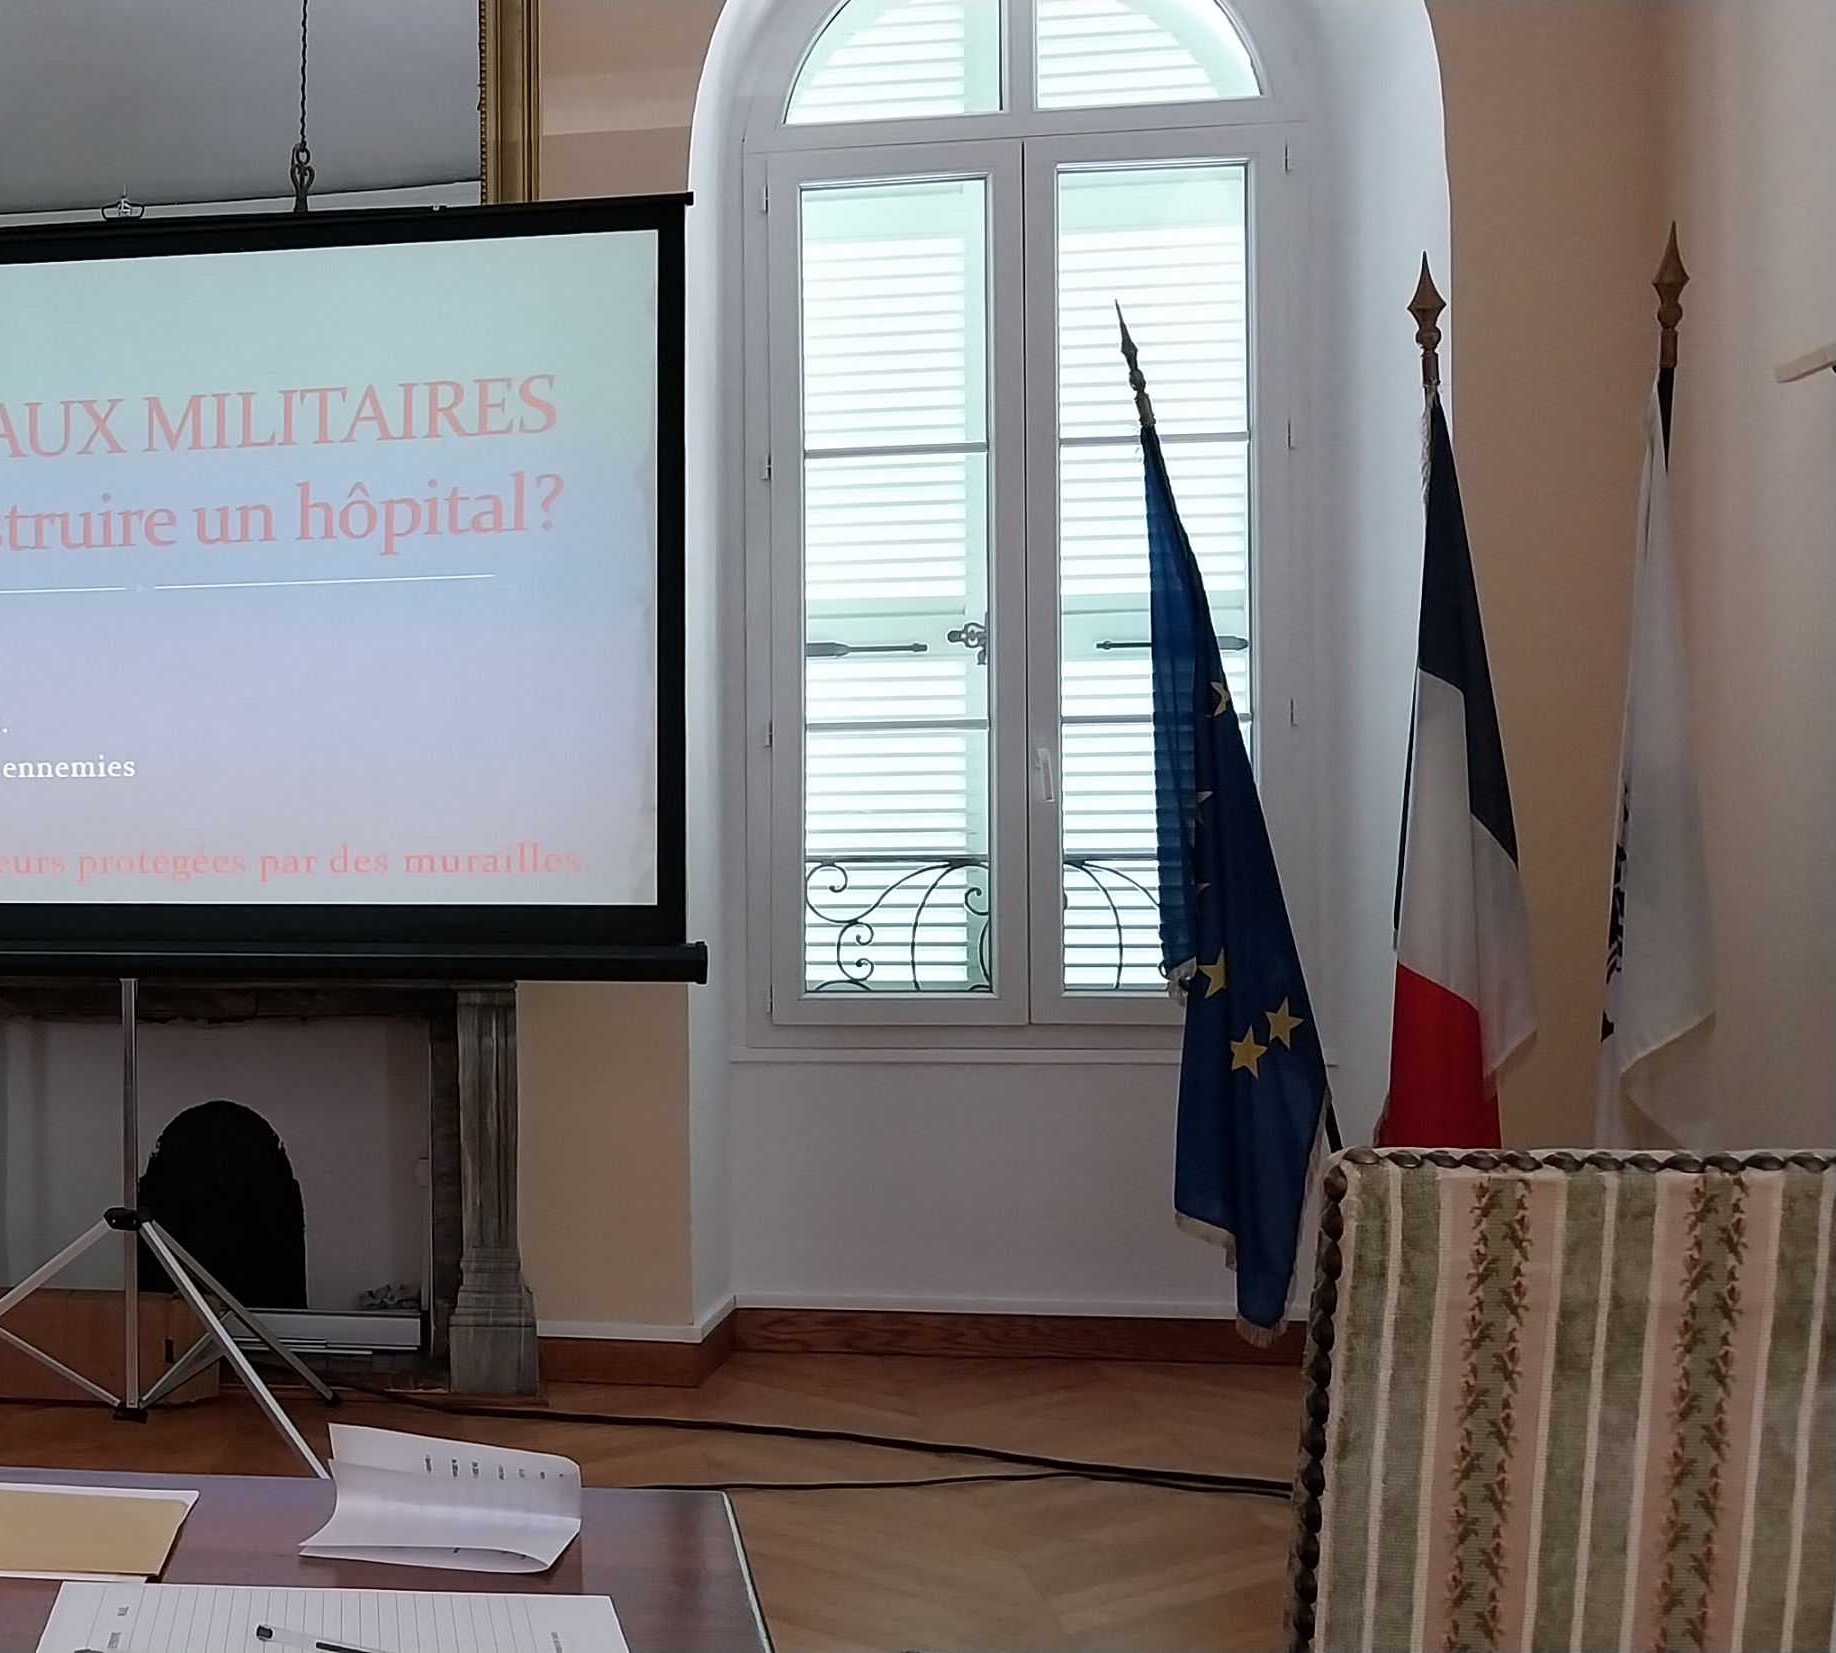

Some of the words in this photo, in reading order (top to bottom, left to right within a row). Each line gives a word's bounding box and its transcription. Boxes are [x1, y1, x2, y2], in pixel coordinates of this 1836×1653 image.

[142, 373, 558, 453] MILITAIRES
[193, 502, 278, 546] un
[295, 470, 564, 556] hôpital?
[3, 754, 136, 778] ennemies
[79, 845, 246, 884] protégées
[260, 853, 319, 884] par
[329, 844, 389, 875] des
[404, 842, 592, 875] murailles.
